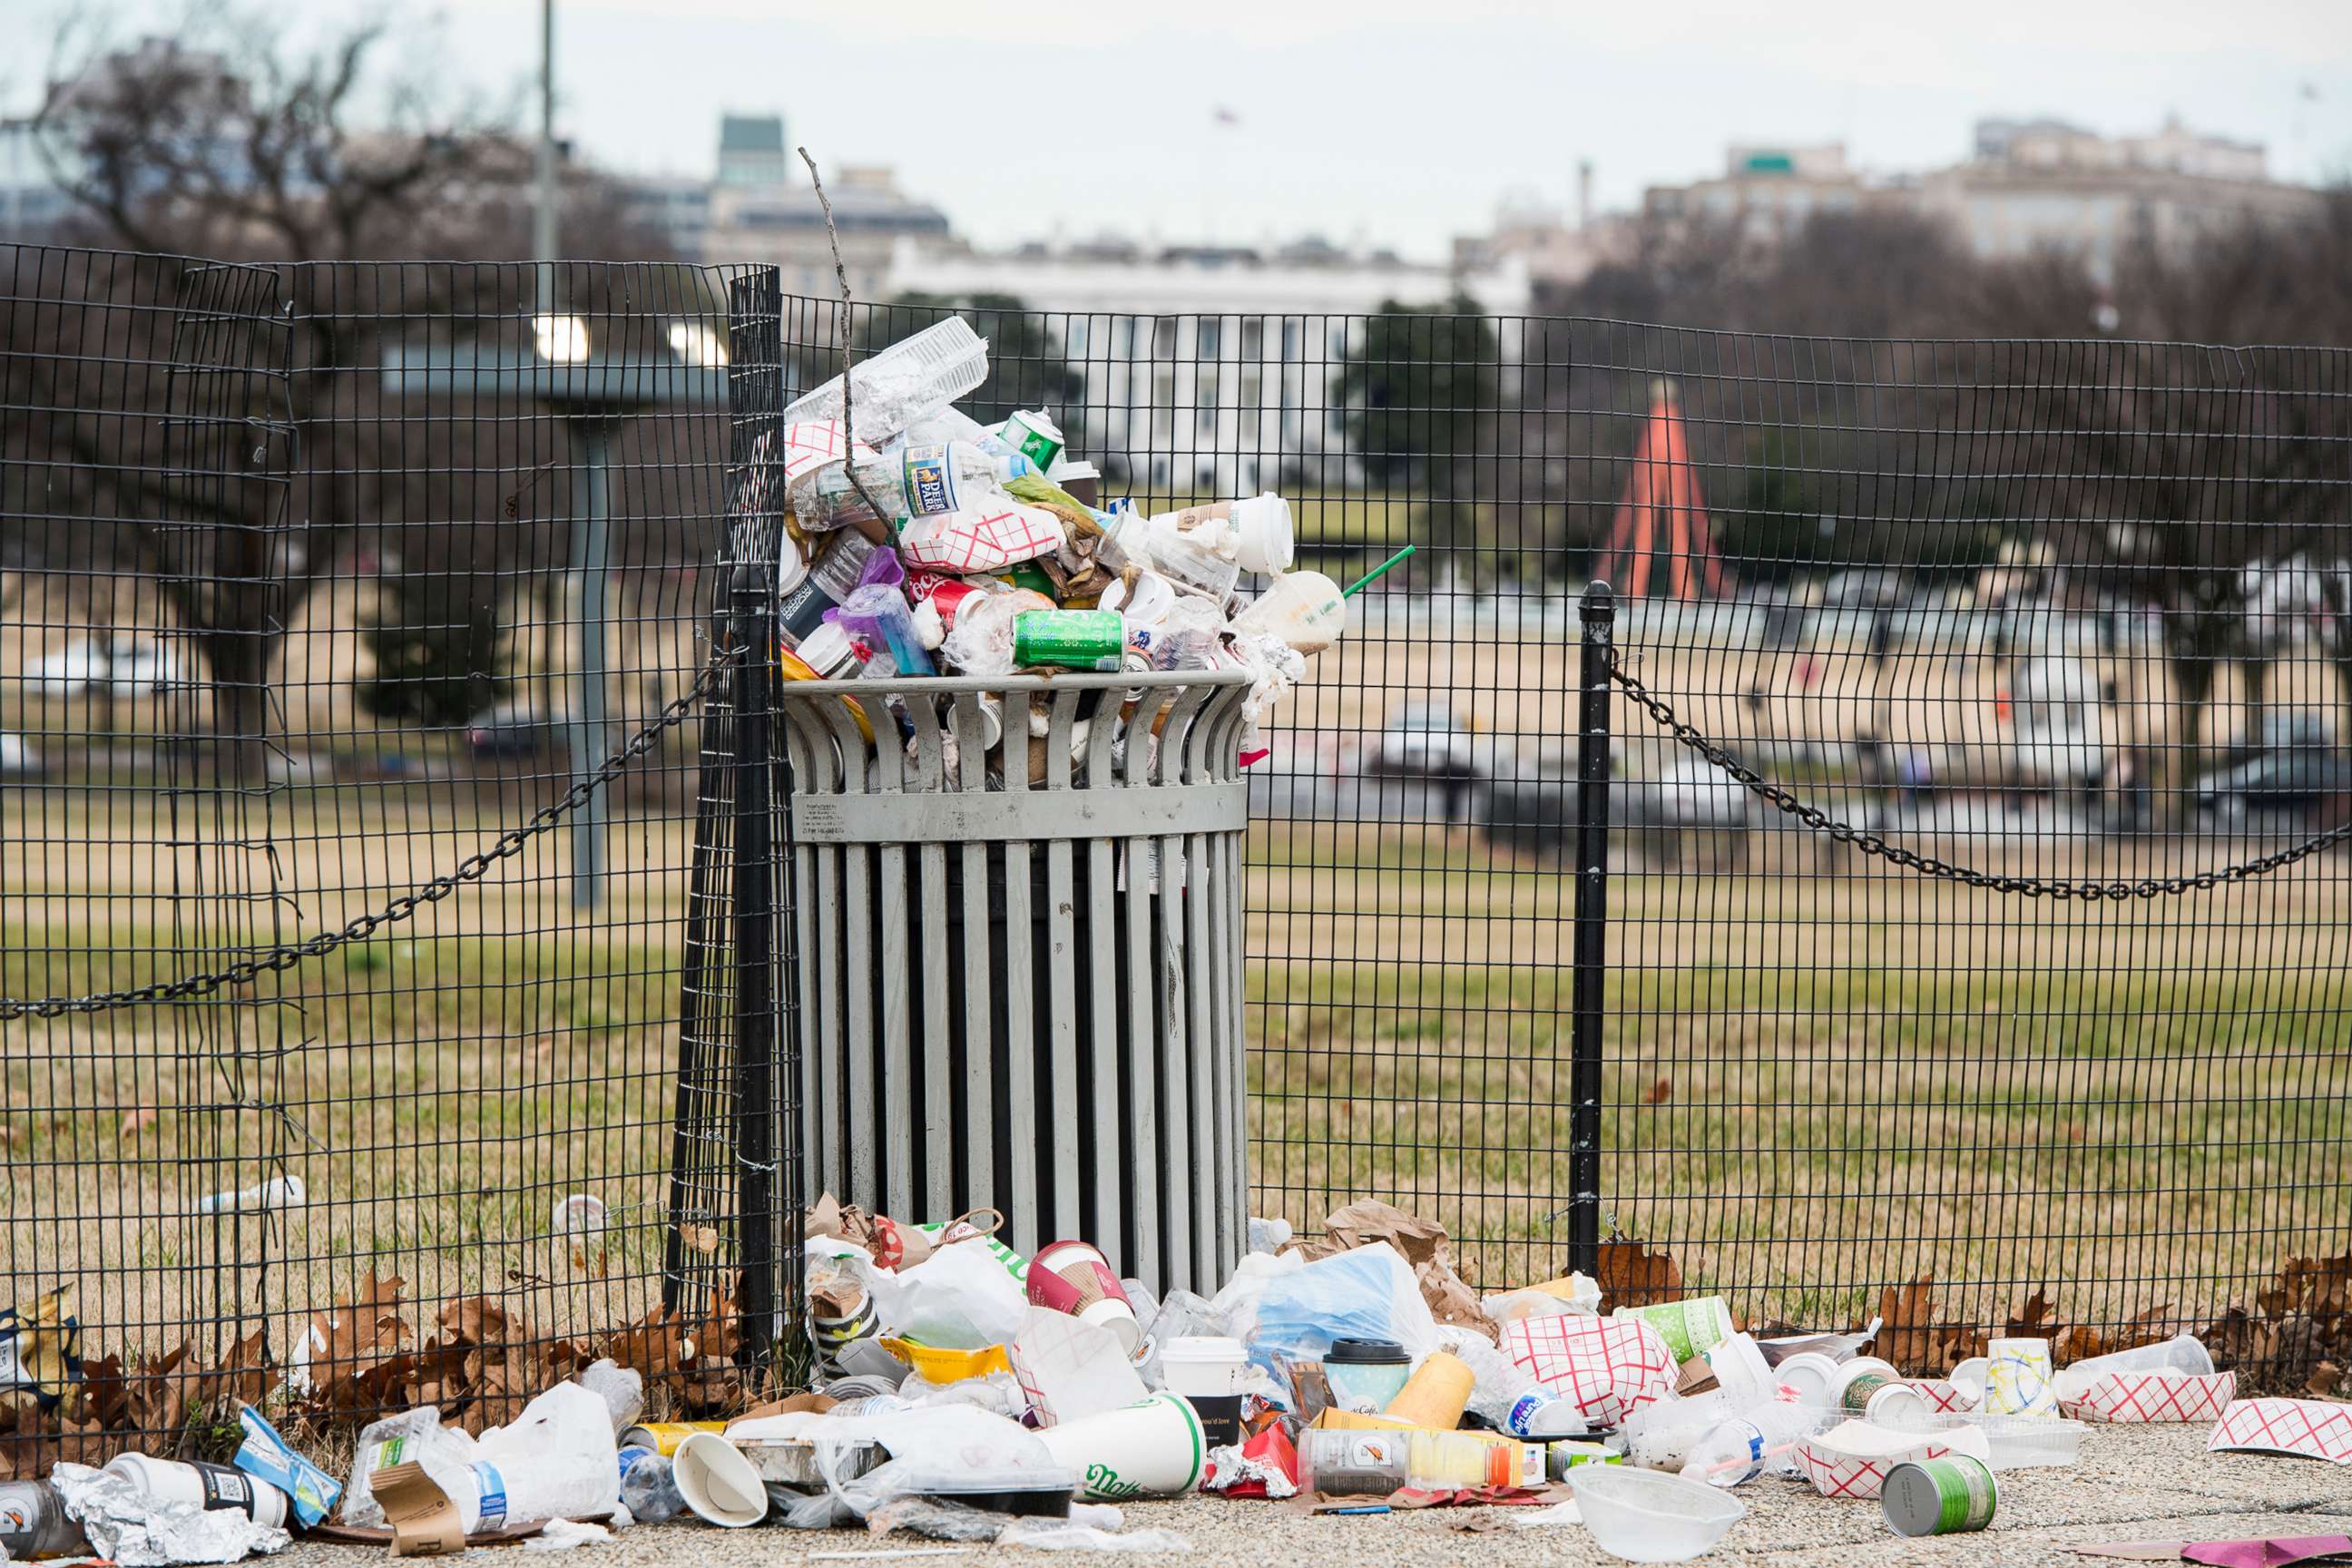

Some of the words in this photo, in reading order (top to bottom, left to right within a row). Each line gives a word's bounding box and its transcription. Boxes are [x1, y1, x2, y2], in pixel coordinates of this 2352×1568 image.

[921, 483, 936, 511] PARK
[930, 480, 946, 509] DEER
[1521, 1398, 1542, 1419] Pure
[1513, 1416, 1526, 1434] Life
